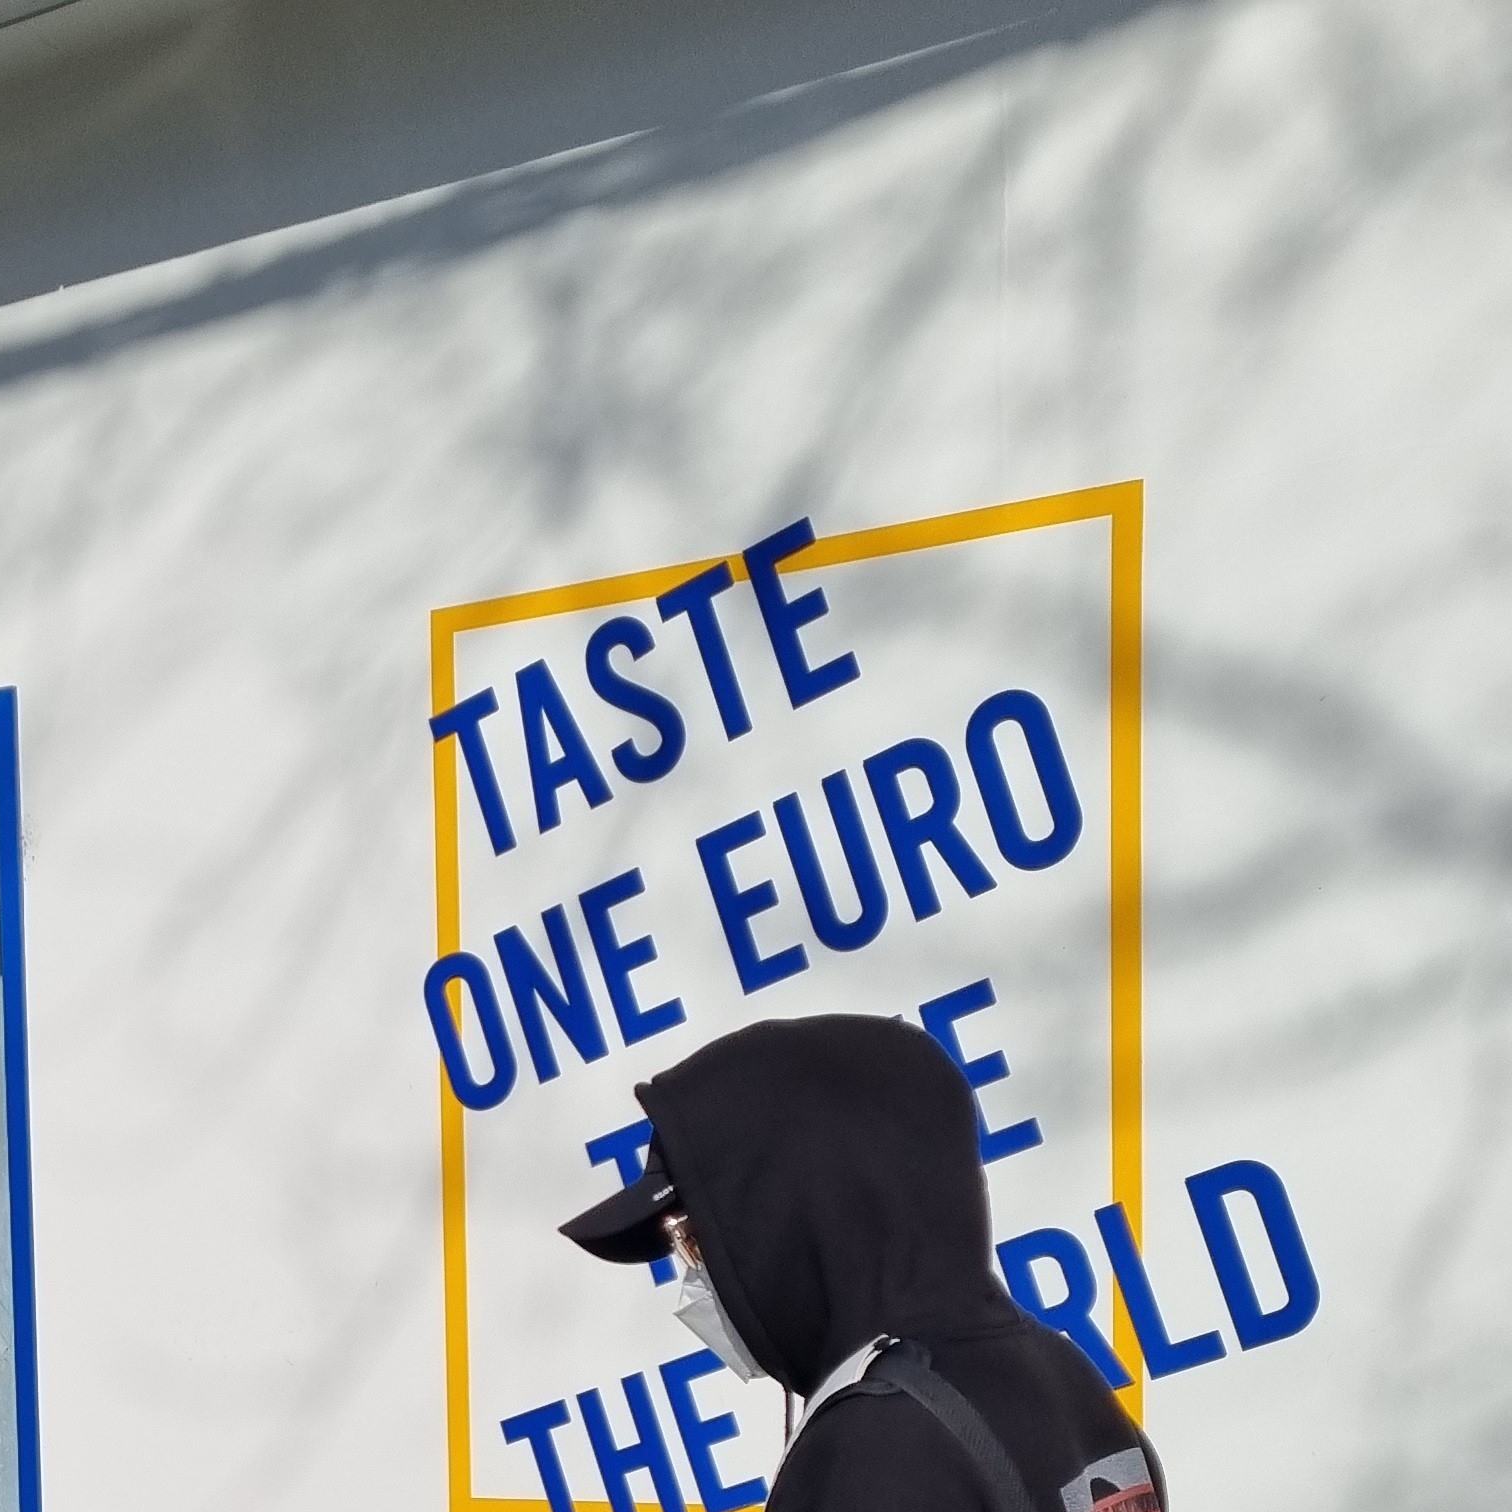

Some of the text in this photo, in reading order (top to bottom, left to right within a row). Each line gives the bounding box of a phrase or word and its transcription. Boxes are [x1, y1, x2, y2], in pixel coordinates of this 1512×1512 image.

[429, 516, 861, 856] TASTE
[423, 689, 1083, 1110] ONE EURO
[996, 1160, 1320, 1390] RLD
